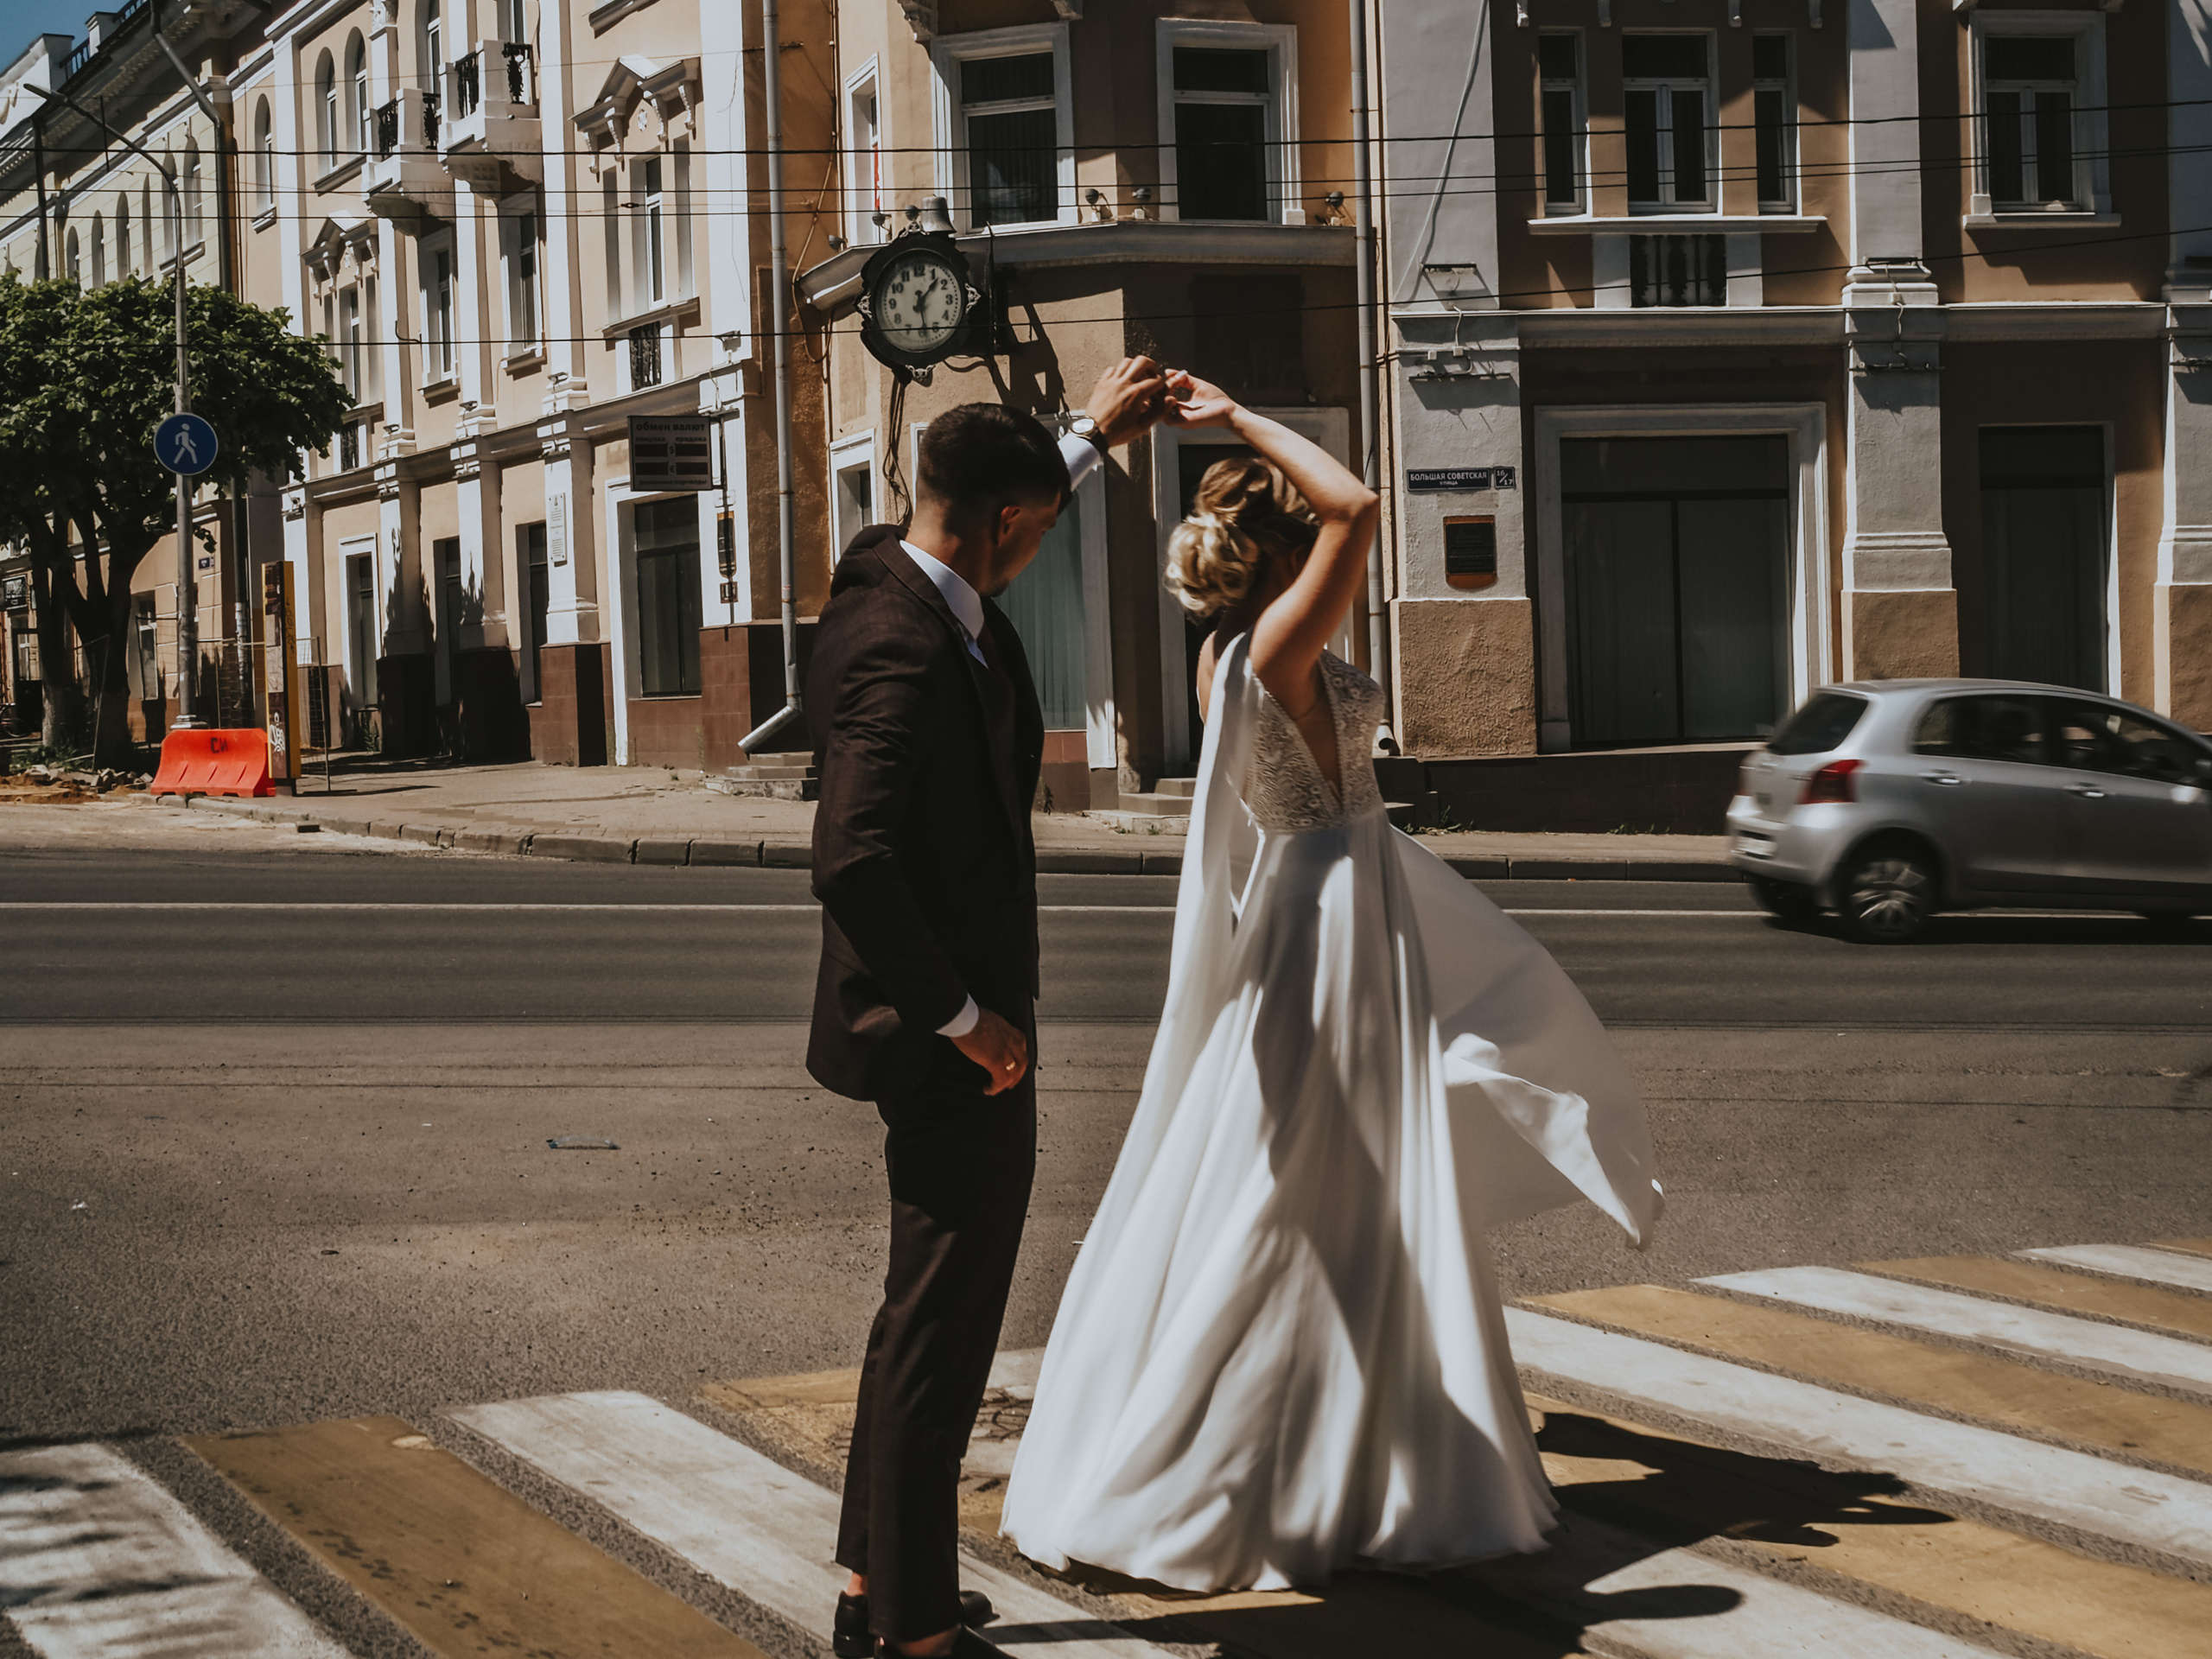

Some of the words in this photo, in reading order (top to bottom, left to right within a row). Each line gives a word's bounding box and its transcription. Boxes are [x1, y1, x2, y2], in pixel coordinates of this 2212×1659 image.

[913, 264, 925, 276] 12
[931, 269, 936, 279] 1
[901, 270, 911, 282] 11
[891, 283, 904, 294] 10
[940, 279, 948, 290] 2
[888, 299, 897, 309] 9
[945, 295, 953, 305] 3
[894, 313, 902, 324] 8
[942, 309, 950, 321] 4
[636, 422, 671, 430] обмен
[1410, 473, 1446, 481] БОЛЬШАЯ
[1446, 472, 1487, 480] СОВЕТСКАЯ
